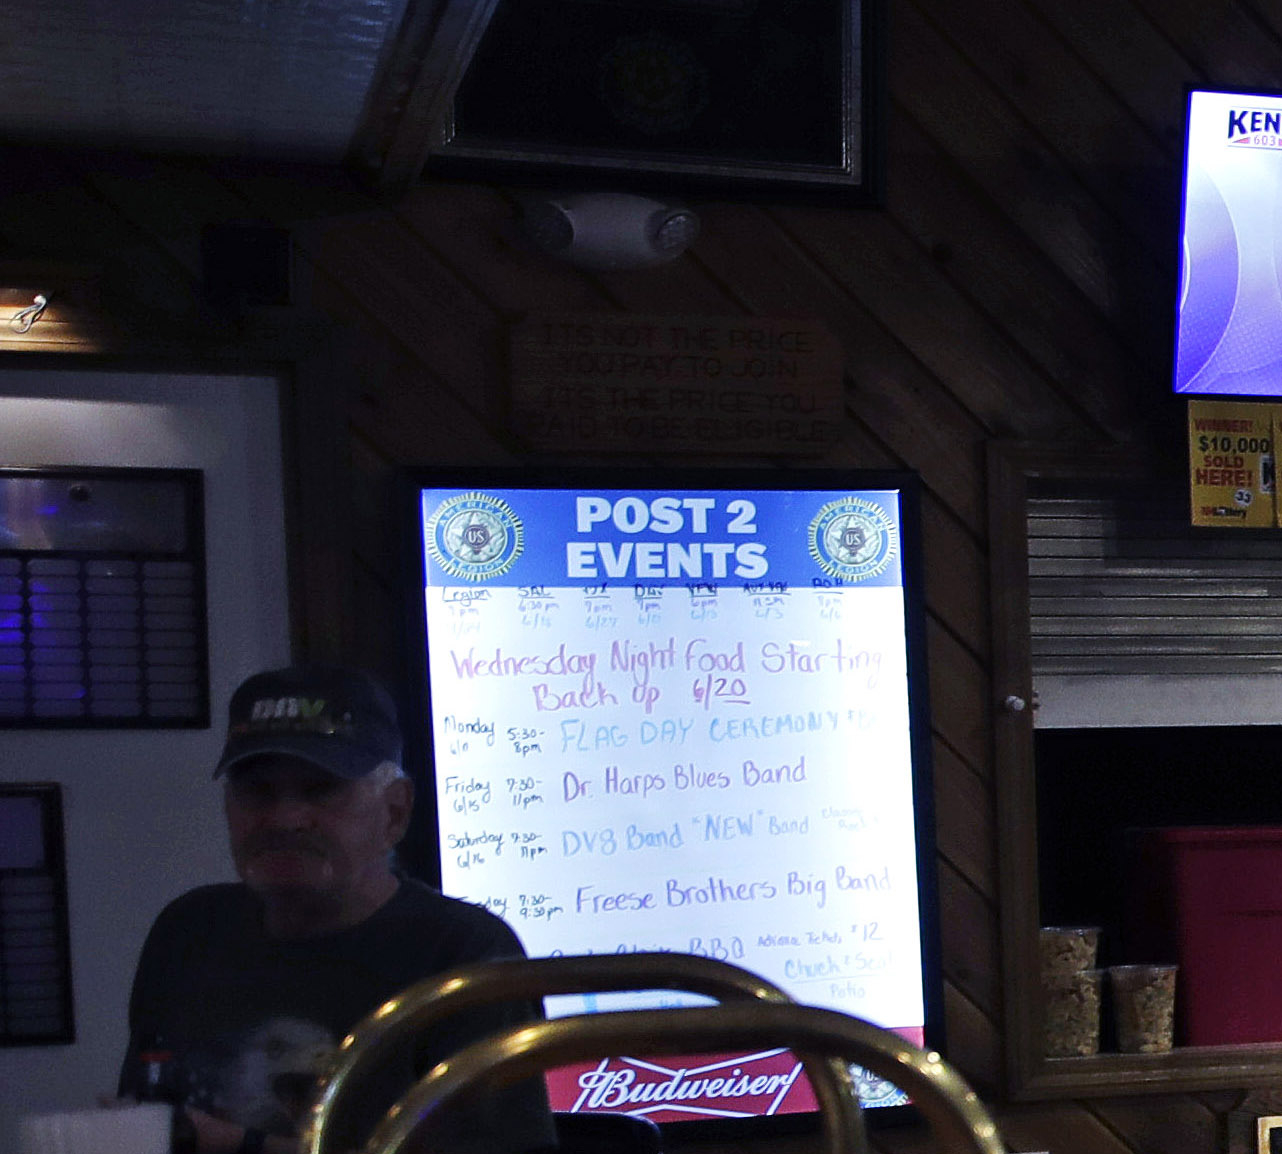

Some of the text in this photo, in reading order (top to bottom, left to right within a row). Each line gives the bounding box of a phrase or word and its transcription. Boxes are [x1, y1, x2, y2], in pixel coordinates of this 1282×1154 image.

[1252, 134, 1278, 148] 603
[1195, 419, 1253, 434] WINNER!
[1198, 435, 1270, 453] $10,000
[1195, 469, 1253, 487] HERE!
[1203, 456, 1244, 468] SOLD
[576, 496, 757, 535] POST 2
[566, 541, 769, 579] EVENTS
[450, 643, 598, 697] Wednesday
[610, 636, 676, 686] Night
[761, 637, 882, 690] Starting
[532, 682, 619, 713] Back
[443, 715, 495, 747] Monday
[560, 711, 839, 753] FLAG DAY CEREMONY
[445, 776, 492, 804] Friday
[605, 764, 665, 797] Harps
[673, 763, 731, 790] Blues
[743, 756, 807, 787] Band
[561, 829, 617, 858] DV8
[625, 823, 686, 851] Band
[766, 815, 811, 837] Band
[576, 865, 892, 916] Freese Brothers Big Band
[579, 1068, 794, 1109] Budweiser
